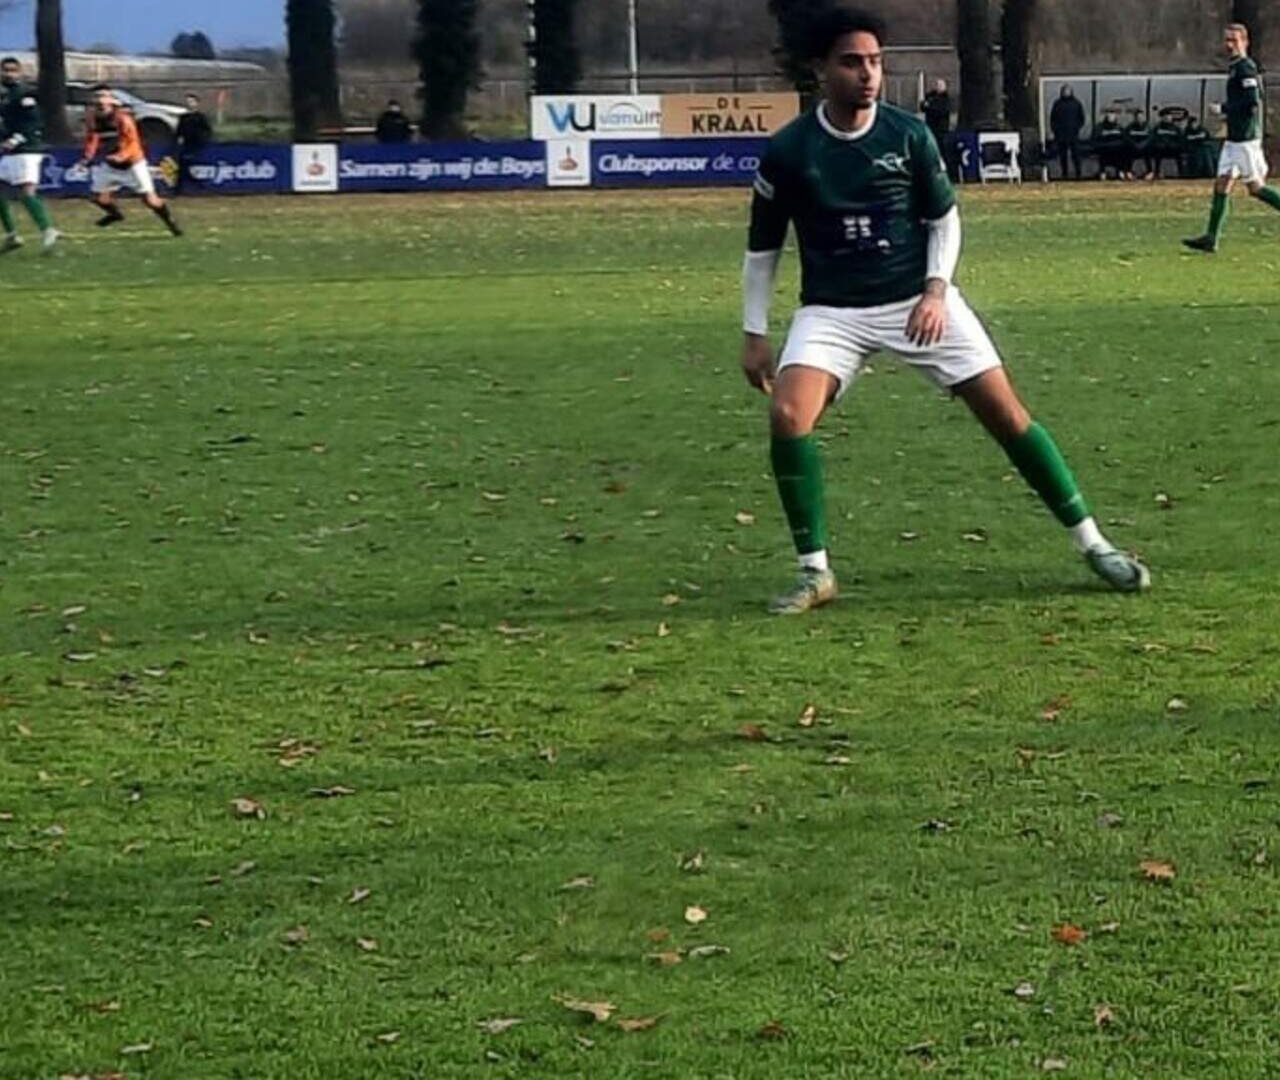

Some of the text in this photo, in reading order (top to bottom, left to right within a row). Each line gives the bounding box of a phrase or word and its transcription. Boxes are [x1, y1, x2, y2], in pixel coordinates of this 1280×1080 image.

[546, 103, 596, 133] VU
[691, 114, 769, 134] KRAAL
[340, 159, 406, 178] Samen
[409, 158, 440, 180] zijn
[443, 157, 472, 180] wij
[473, 157, 500, 177] de
[501, 156, 545, 179] Boys
[598, 153, 709, 176] Clubsponsor
[713, 153, 734, 170] de
